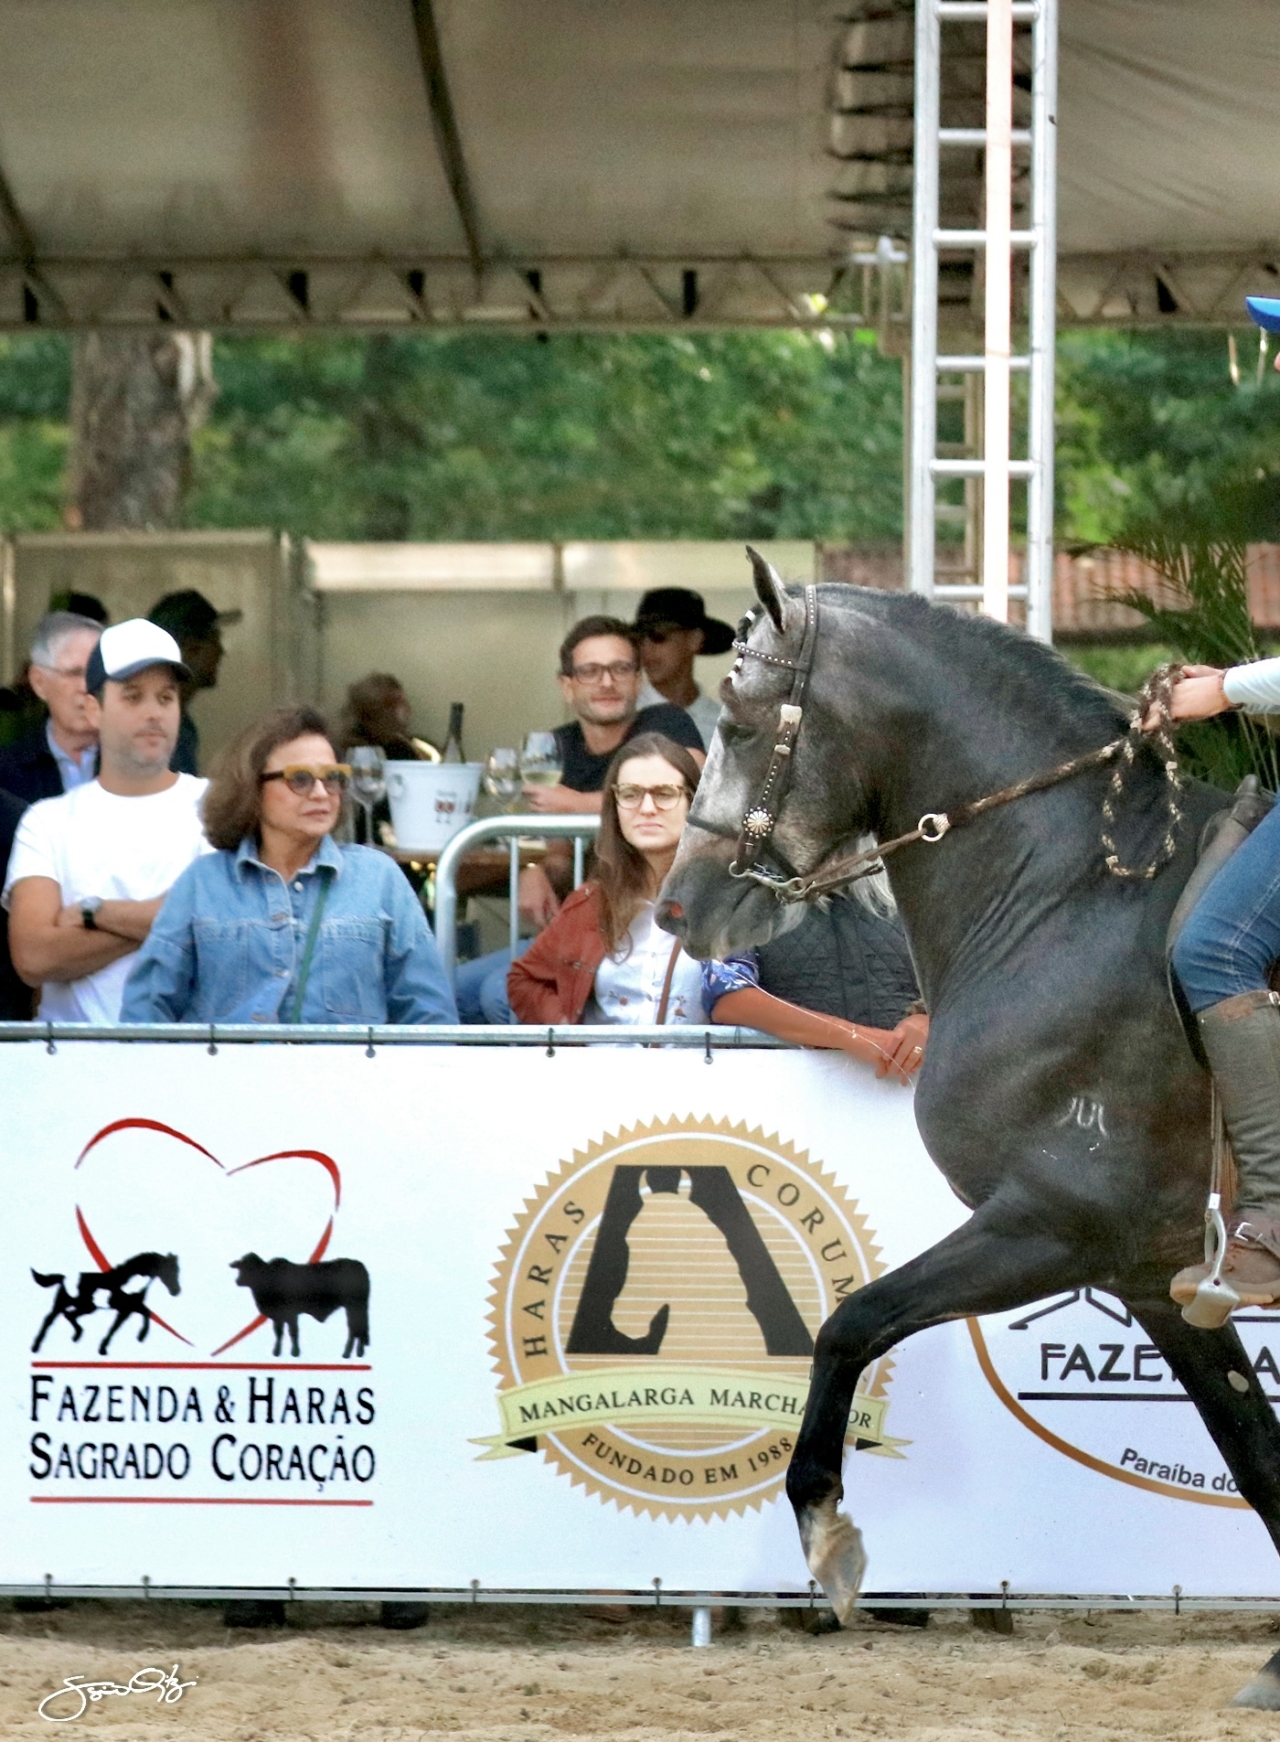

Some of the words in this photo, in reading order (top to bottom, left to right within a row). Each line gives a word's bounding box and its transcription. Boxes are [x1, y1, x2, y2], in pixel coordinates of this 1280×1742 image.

[522, 1200, 586, 1359] HARAS
[746, 1163, 856, 1304] CORUM
[29, 1374, 204, 1423] FAZENDA
[213, 1384, 237, 1423] &
[247, 1376, 376, 1425] HARAS
[518, 1387, 695, 1424] MANGALARGA
[709, 1388, 872, 1429] MARCHOR
[28, 1431, 191, 1480] SAGRADO
[211, 1432, 376, 1493] CORAÇÃO
[581, 1432, 695, 1487] FUNDADO
[704, 1463, 739, 1485] EM
[748, 1436, 794, 1473] 1988
[1119, 1448, 1206, 1488] Paraíba
